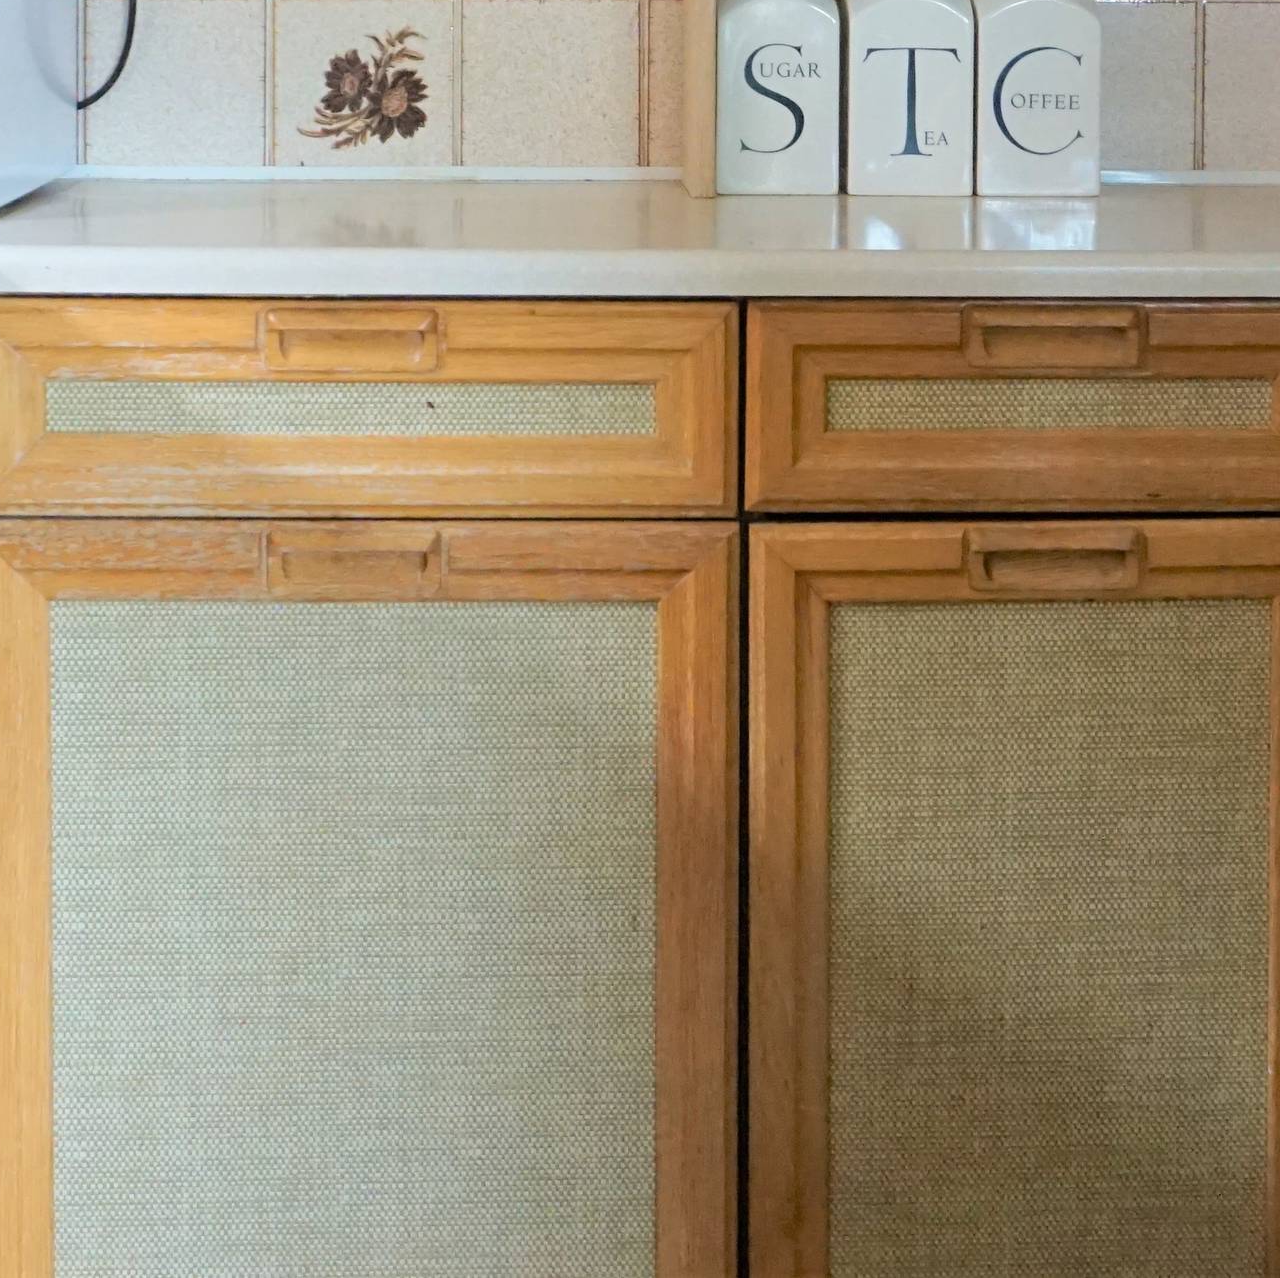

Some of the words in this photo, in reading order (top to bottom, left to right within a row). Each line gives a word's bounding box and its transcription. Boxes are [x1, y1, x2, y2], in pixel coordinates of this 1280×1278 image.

[739, 42, 821, 154] SUGAR
[863, 46, 961, 157] TEA
[992, 46, 1085, 156] COFFEE
